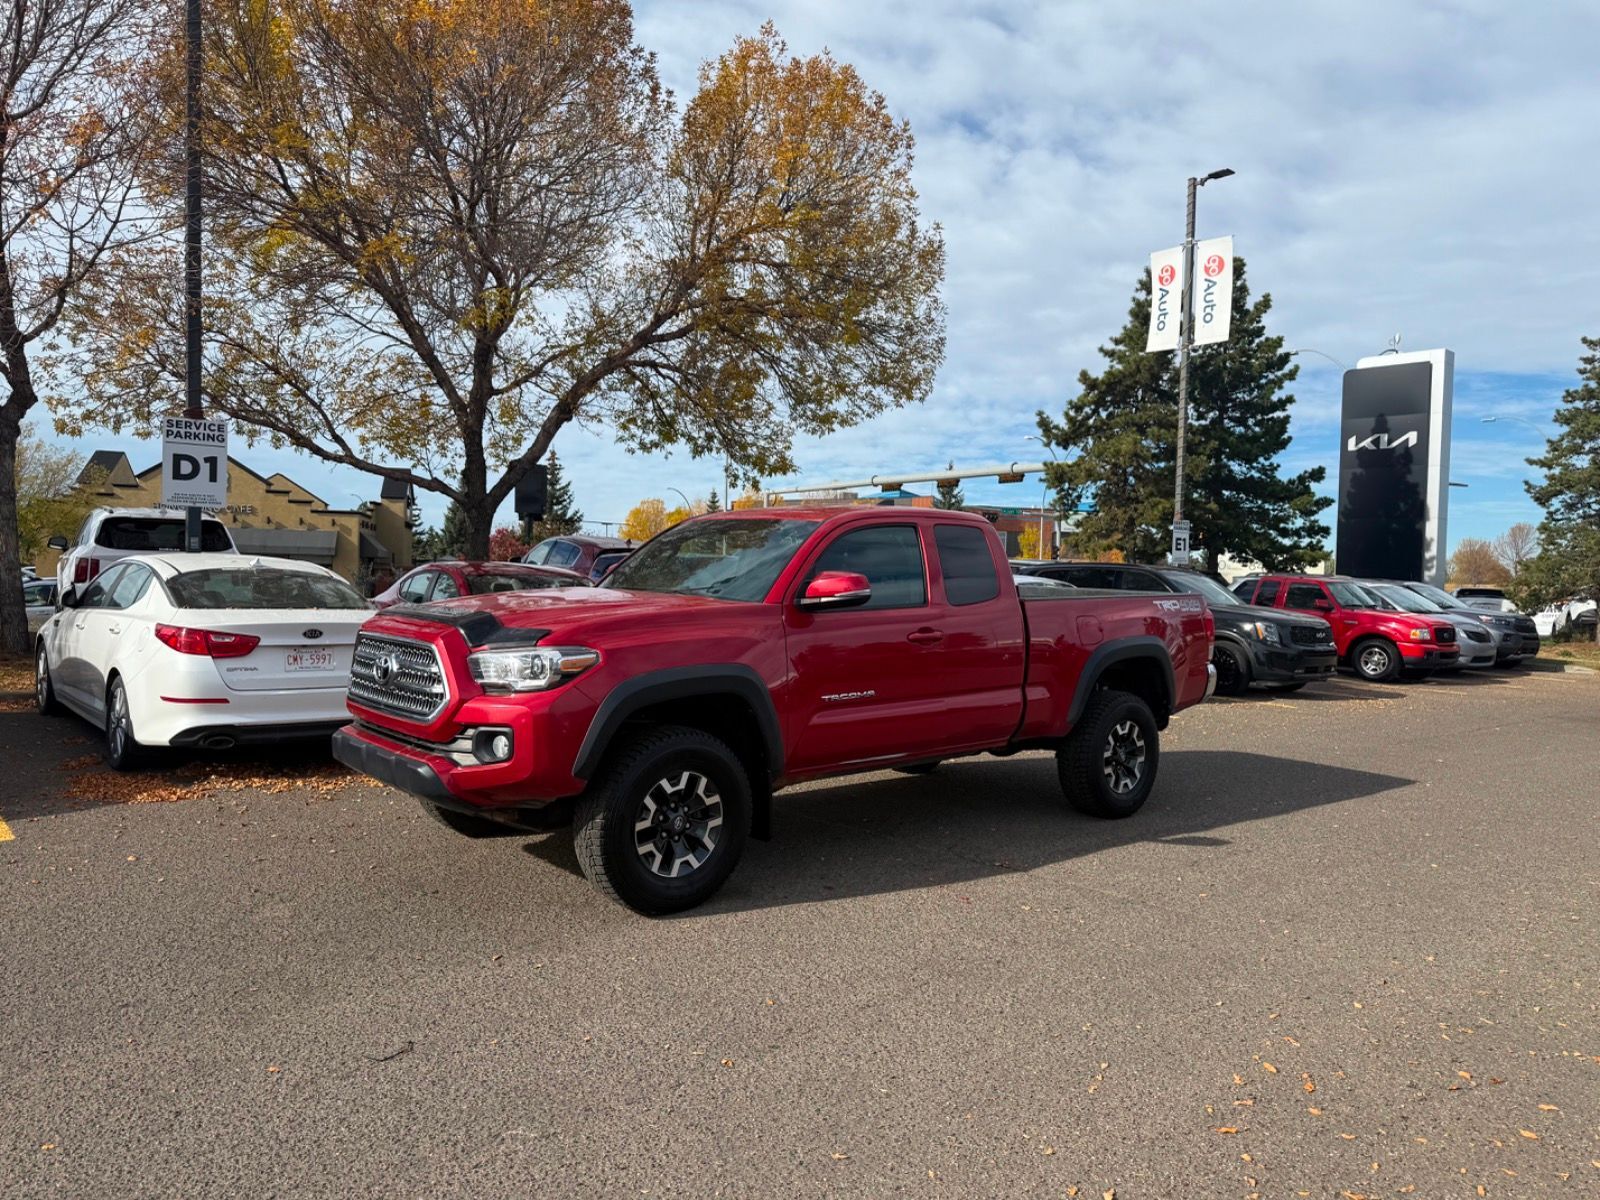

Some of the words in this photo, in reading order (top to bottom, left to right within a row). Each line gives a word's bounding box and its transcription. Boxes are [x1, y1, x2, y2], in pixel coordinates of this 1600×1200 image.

[1203, 278, 1217, 323] Auto
[1157, 287, 1169, 331] Auto
[166, 419, 225, 432] SERVICE
[166, 430, 225, 443] PARKING
[172, 453, 218, 483] D1
[1175, 537, 1186, 551] E1
[1153, 600, 1180, 611] TRD
[303, 629, 323, 639] KIA
[287, 653, 332, 665] CMY-5997
[821, 690, 875, 701] TACOMA
